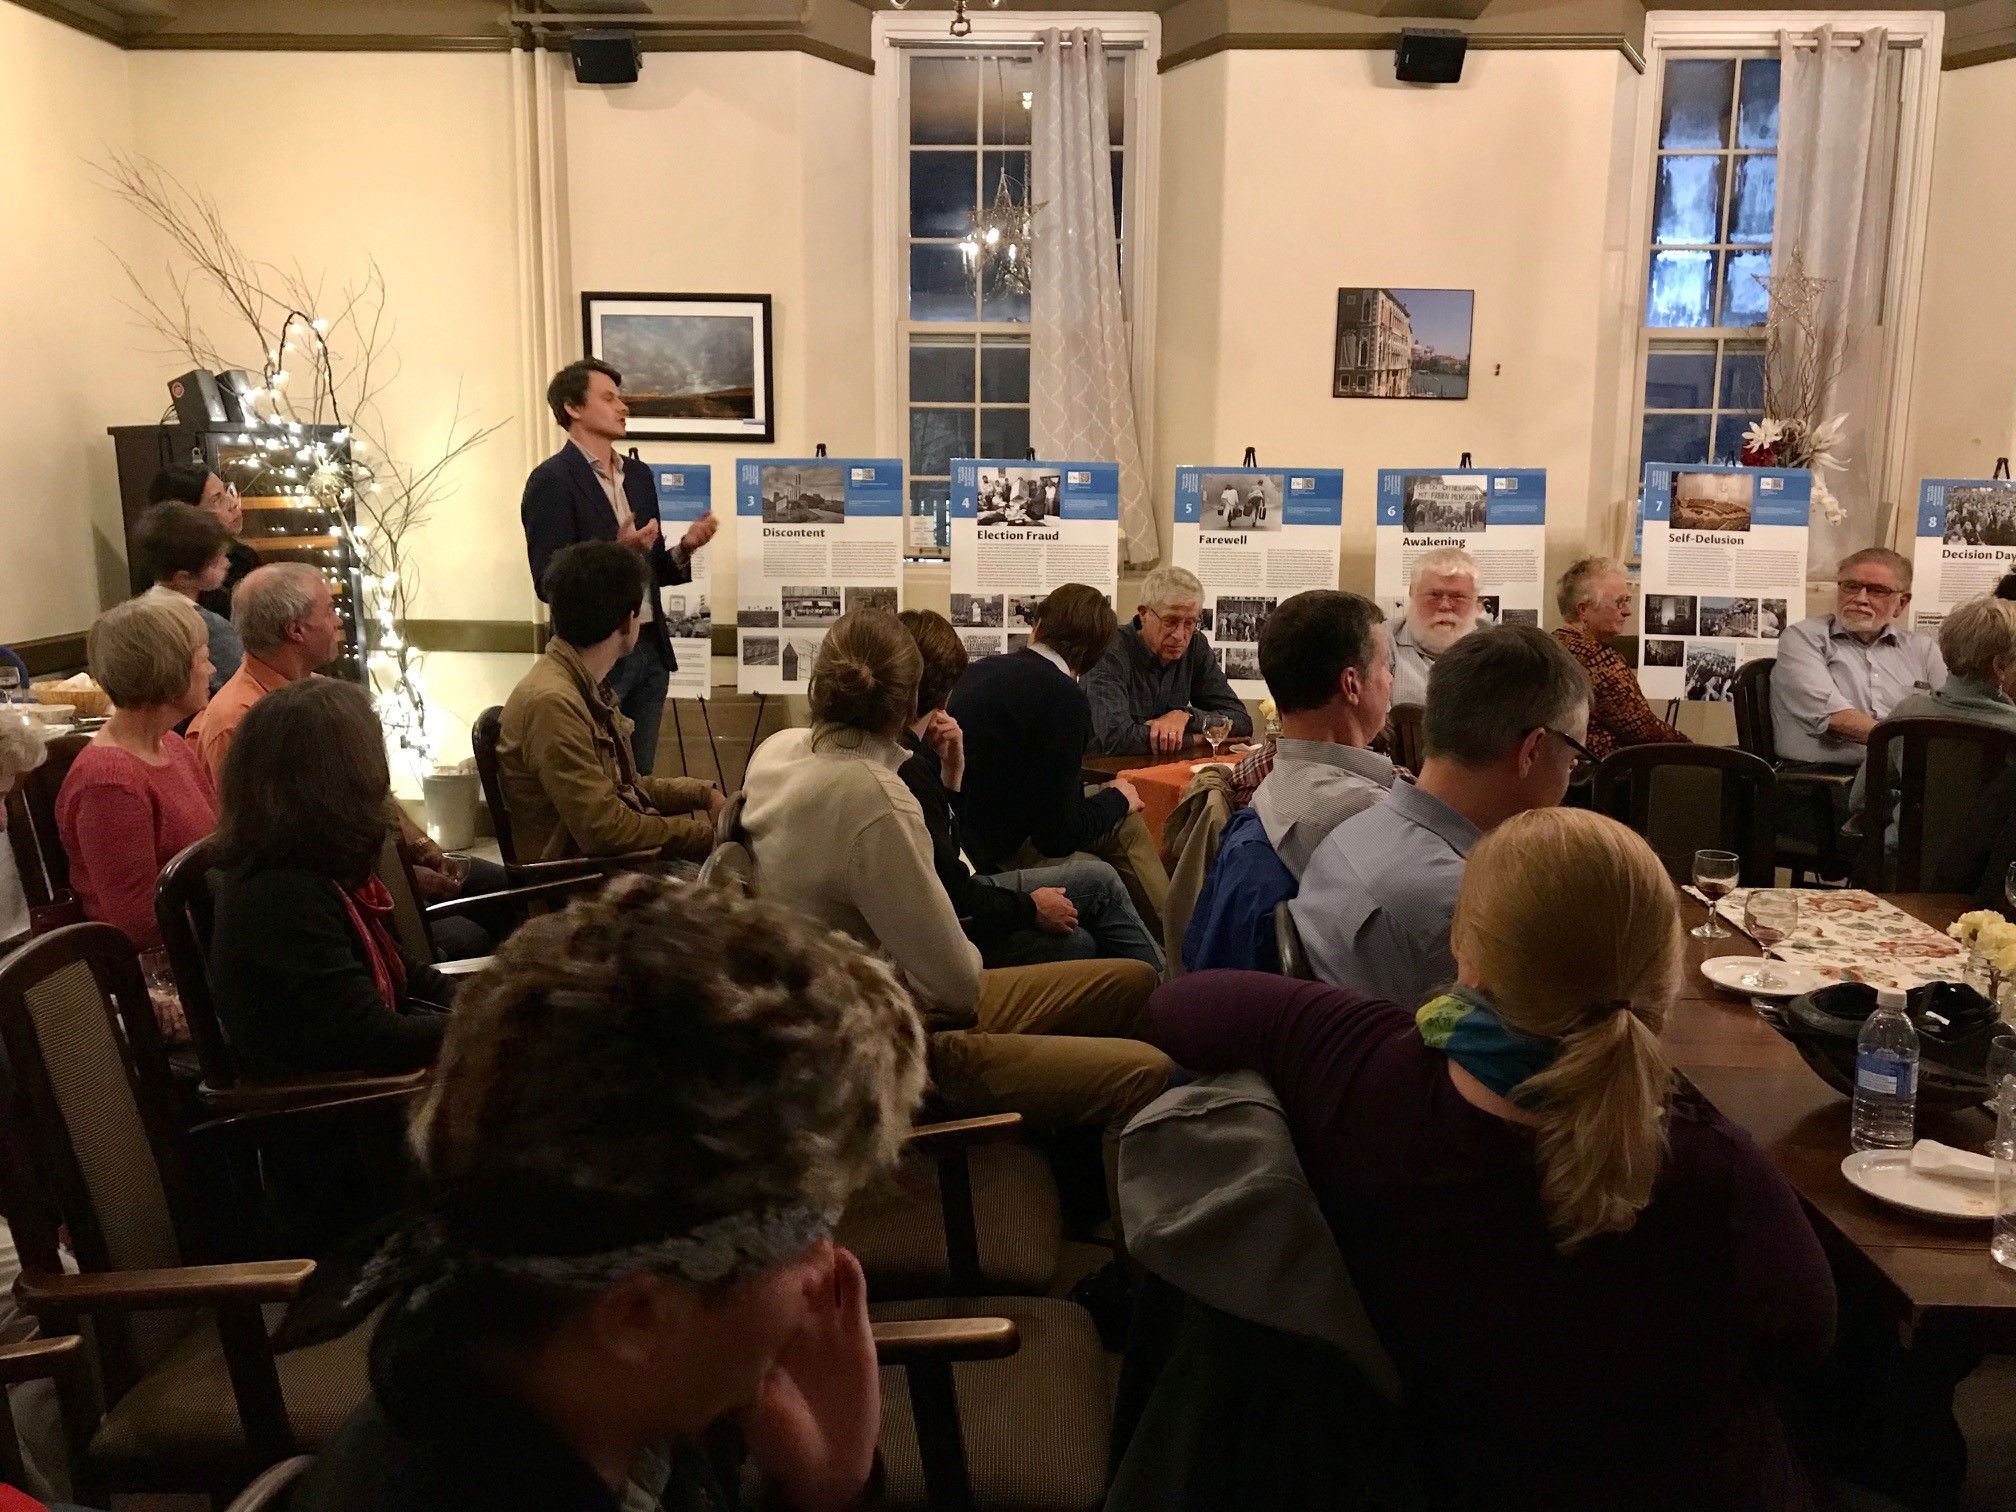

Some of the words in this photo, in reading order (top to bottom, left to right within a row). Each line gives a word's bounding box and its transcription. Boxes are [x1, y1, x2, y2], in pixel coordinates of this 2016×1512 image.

[747, 495, 755, 507] 3
[961, 497, 971, 509] 4
[1656, 500, 1663, 512] 7
[1185, 503, 1193, 514] 5
[1387, 505, 1396, 517] 6
[1928, 516, 1938, 528] 8
[762, 527, 826, 538] Discontent
[977, 530, 1024, 541] Election
[1026, 531, 1059, 541] Fraud
[1199, 534, 1248, 545] Farewell
[1402, 537, 1466, 549] Awakening
[1668, 533, 1745, 546] Self-Delusion
[1942, 549, 1993, 560] Decision
[1995, 551, 2016, 562] Day
